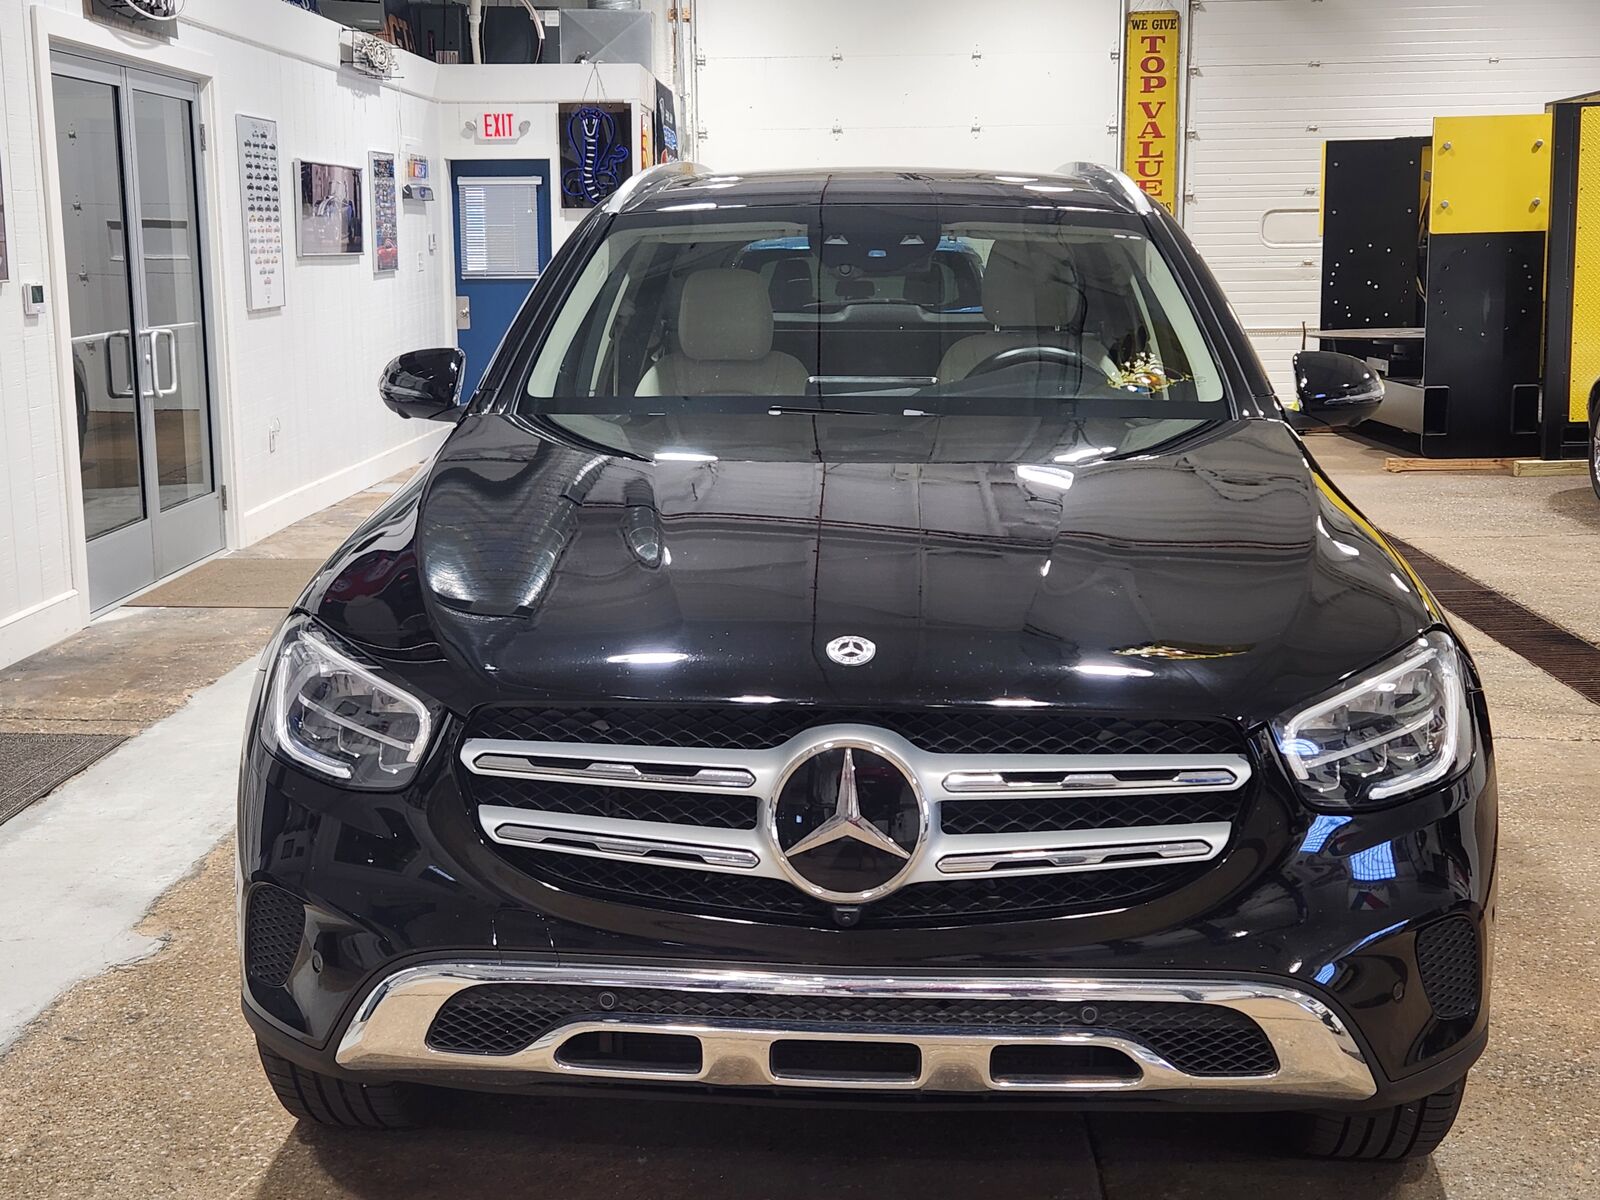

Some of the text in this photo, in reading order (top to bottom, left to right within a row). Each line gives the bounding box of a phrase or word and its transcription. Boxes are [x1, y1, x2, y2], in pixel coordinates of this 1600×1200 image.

[1131, 19, 1177, 30] WE GIVE
[1140, 36, 1167, 93] TOP
[484, 113, 514, 137] EXIT
[1135, 102, 1166, 196] VALUE
